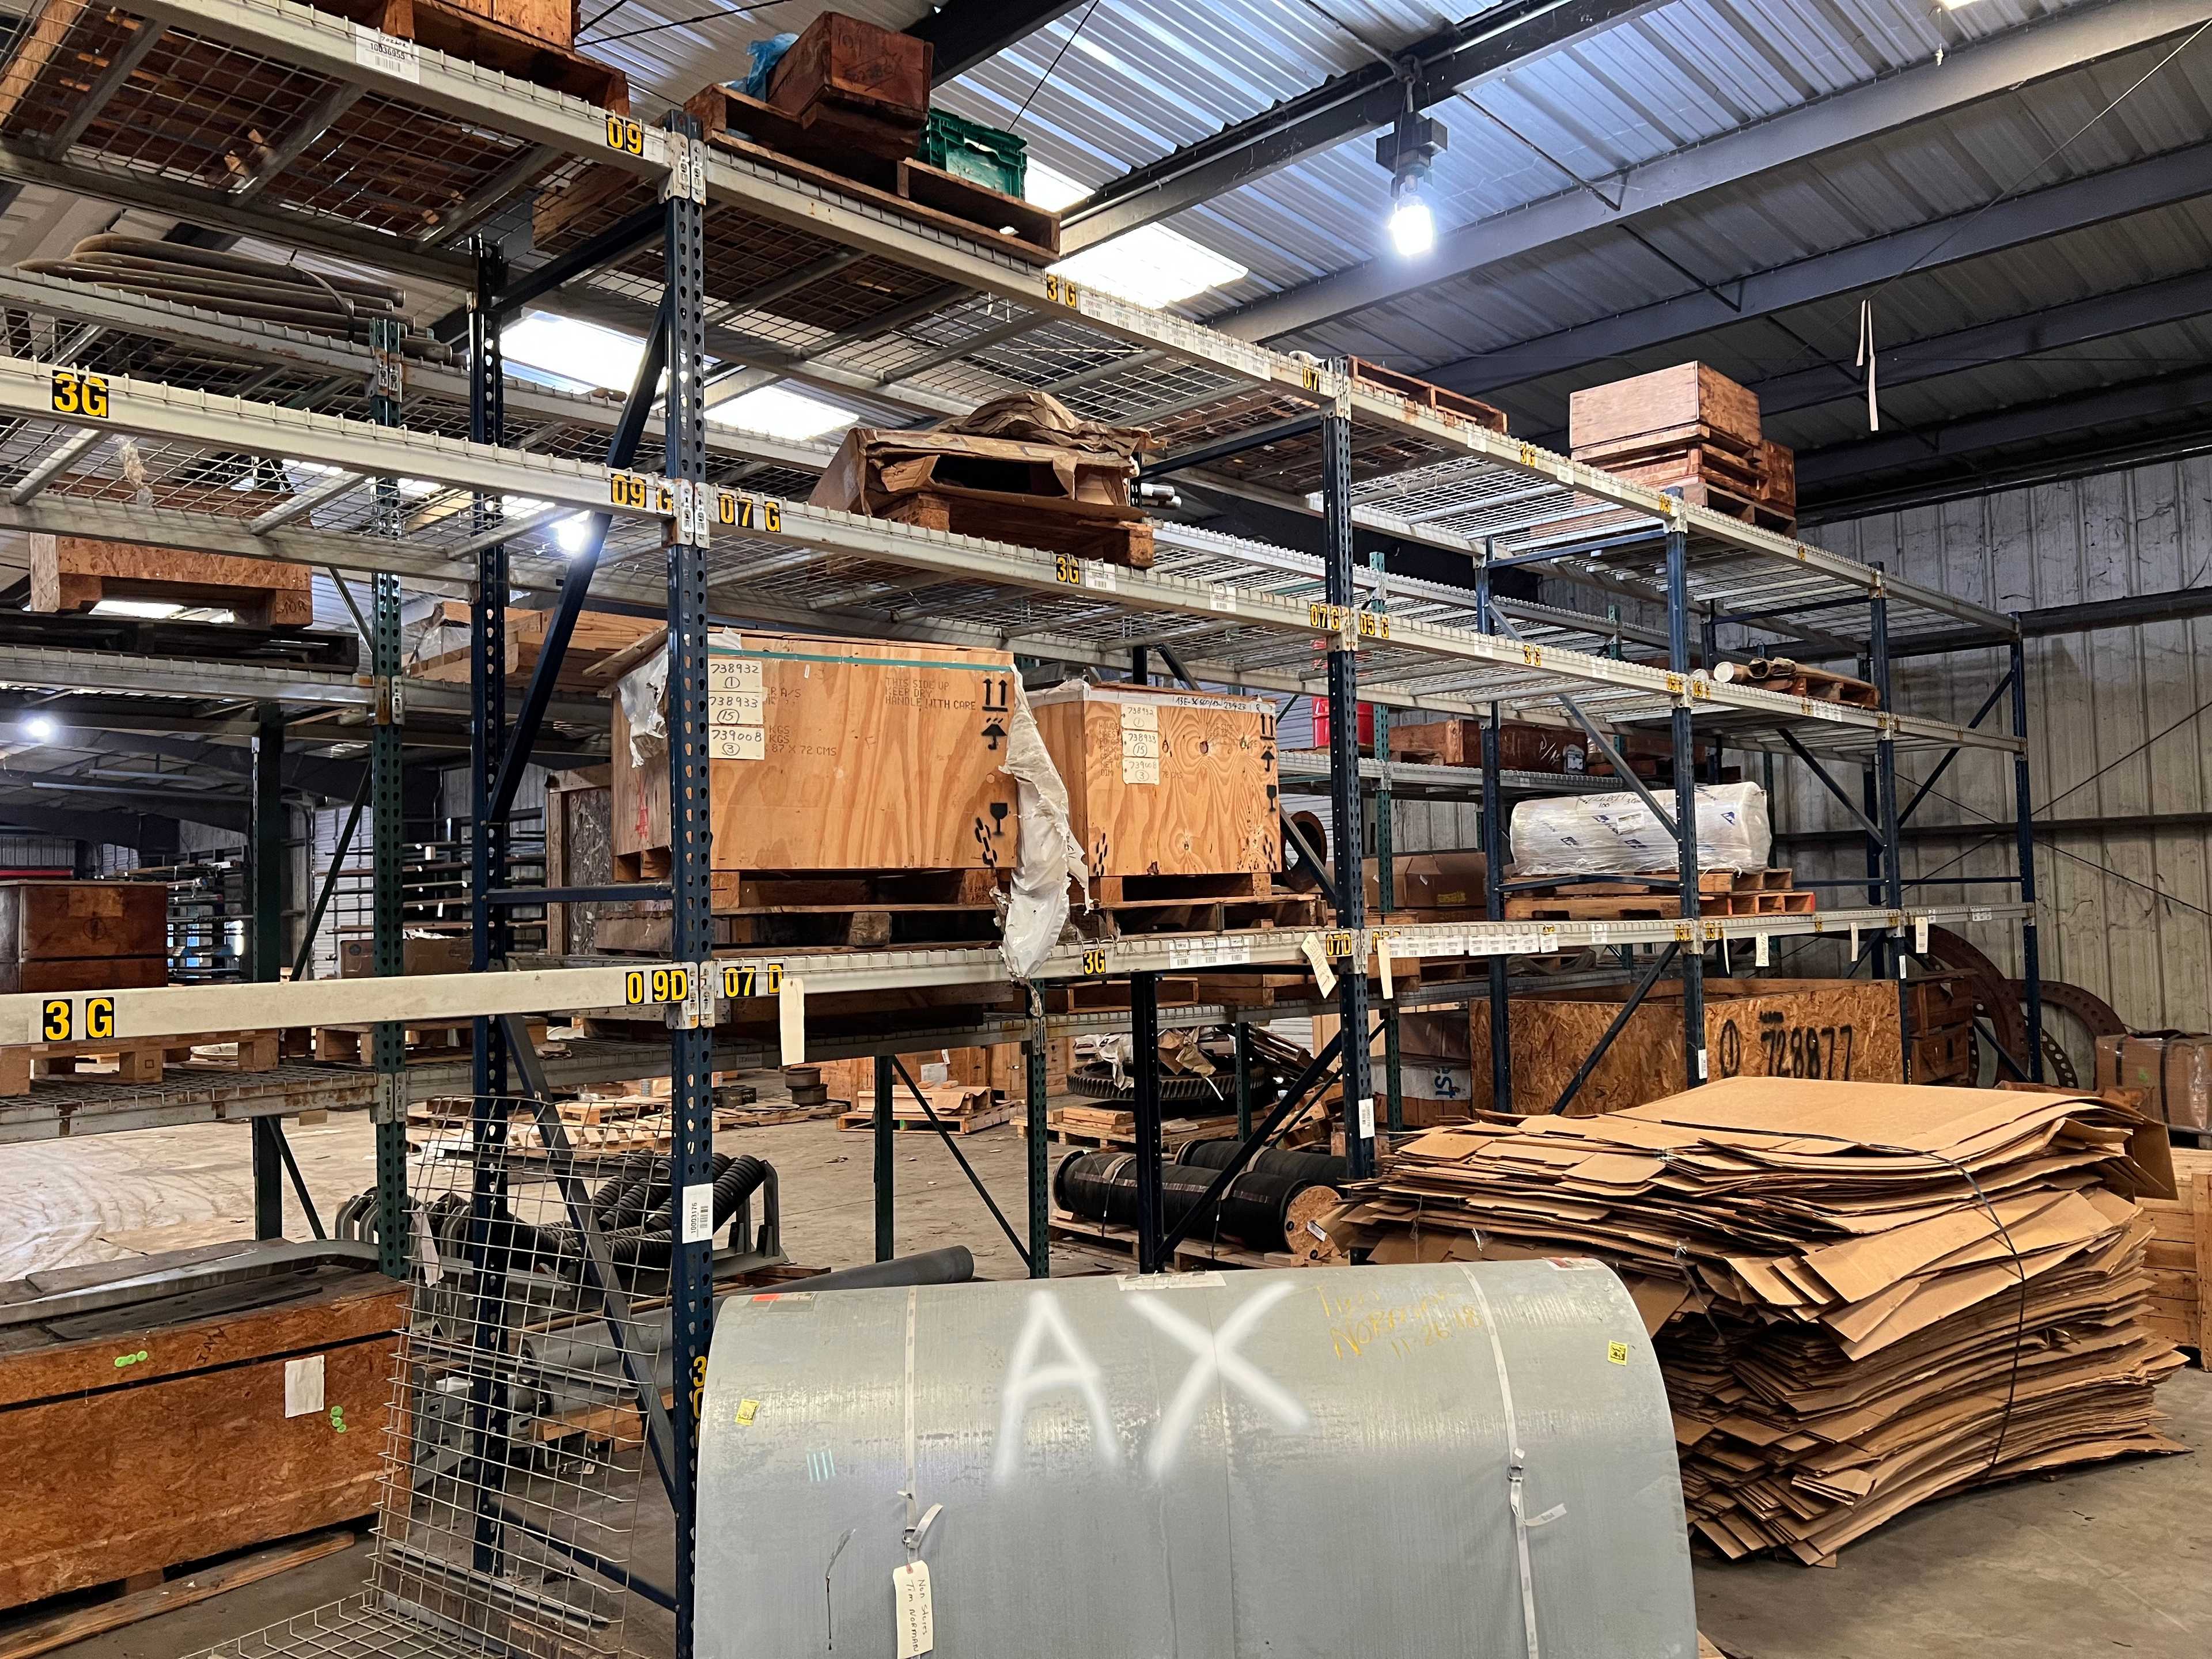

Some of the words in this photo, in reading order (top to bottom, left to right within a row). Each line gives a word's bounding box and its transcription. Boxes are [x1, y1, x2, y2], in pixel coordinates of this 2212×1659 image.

[370, 43, 406, 59] 10036955
[607, 117, 642, 155] 09
[1302, 368, 1319, 392] 07
[54, 373, 107, 417] 3G
[612, 474, 645, 508] 09
[719, 494, 753, 527] 07
[764, 501, 780, 532] G
[1359, 612, 1376, 636] 05
[710, 663, 760, 674] 738932
[885, 677, 908, 687] THIS
[913, 680, 936, 689] SIDE
[938, 681, 949, 691] UP
[781, 687, 801, 698] A/S
[885, 687, 910, 696] KEEP
[709, 696, 758, 708] 738933
[885, 696, 922, 707] HANDLE
[925, 699, 950, 709] WITH
[953, 700, 976, 710] CARE
[1127, 707, 1154, 717] 738932
[711, 729, 762, 743] 739008
[769, 725, 790, 734] KGS
[769, 734, 790, 744] KGS
[1128, 733, 1156, 744] 738933
[772, 744, 785, 753] 87
[800, 745, 813, 755] 72
[816, 747, 837, 756] CMS
[1084, 950, 1105, 975] 3G
[725, 967, 755, 998] 07
[768, 964, 782, 994] D
[45, 1001, 70, 1040] 3
[87, 998, 112, 1038] G
[1760, 1024, 1853, 1081] 728877
